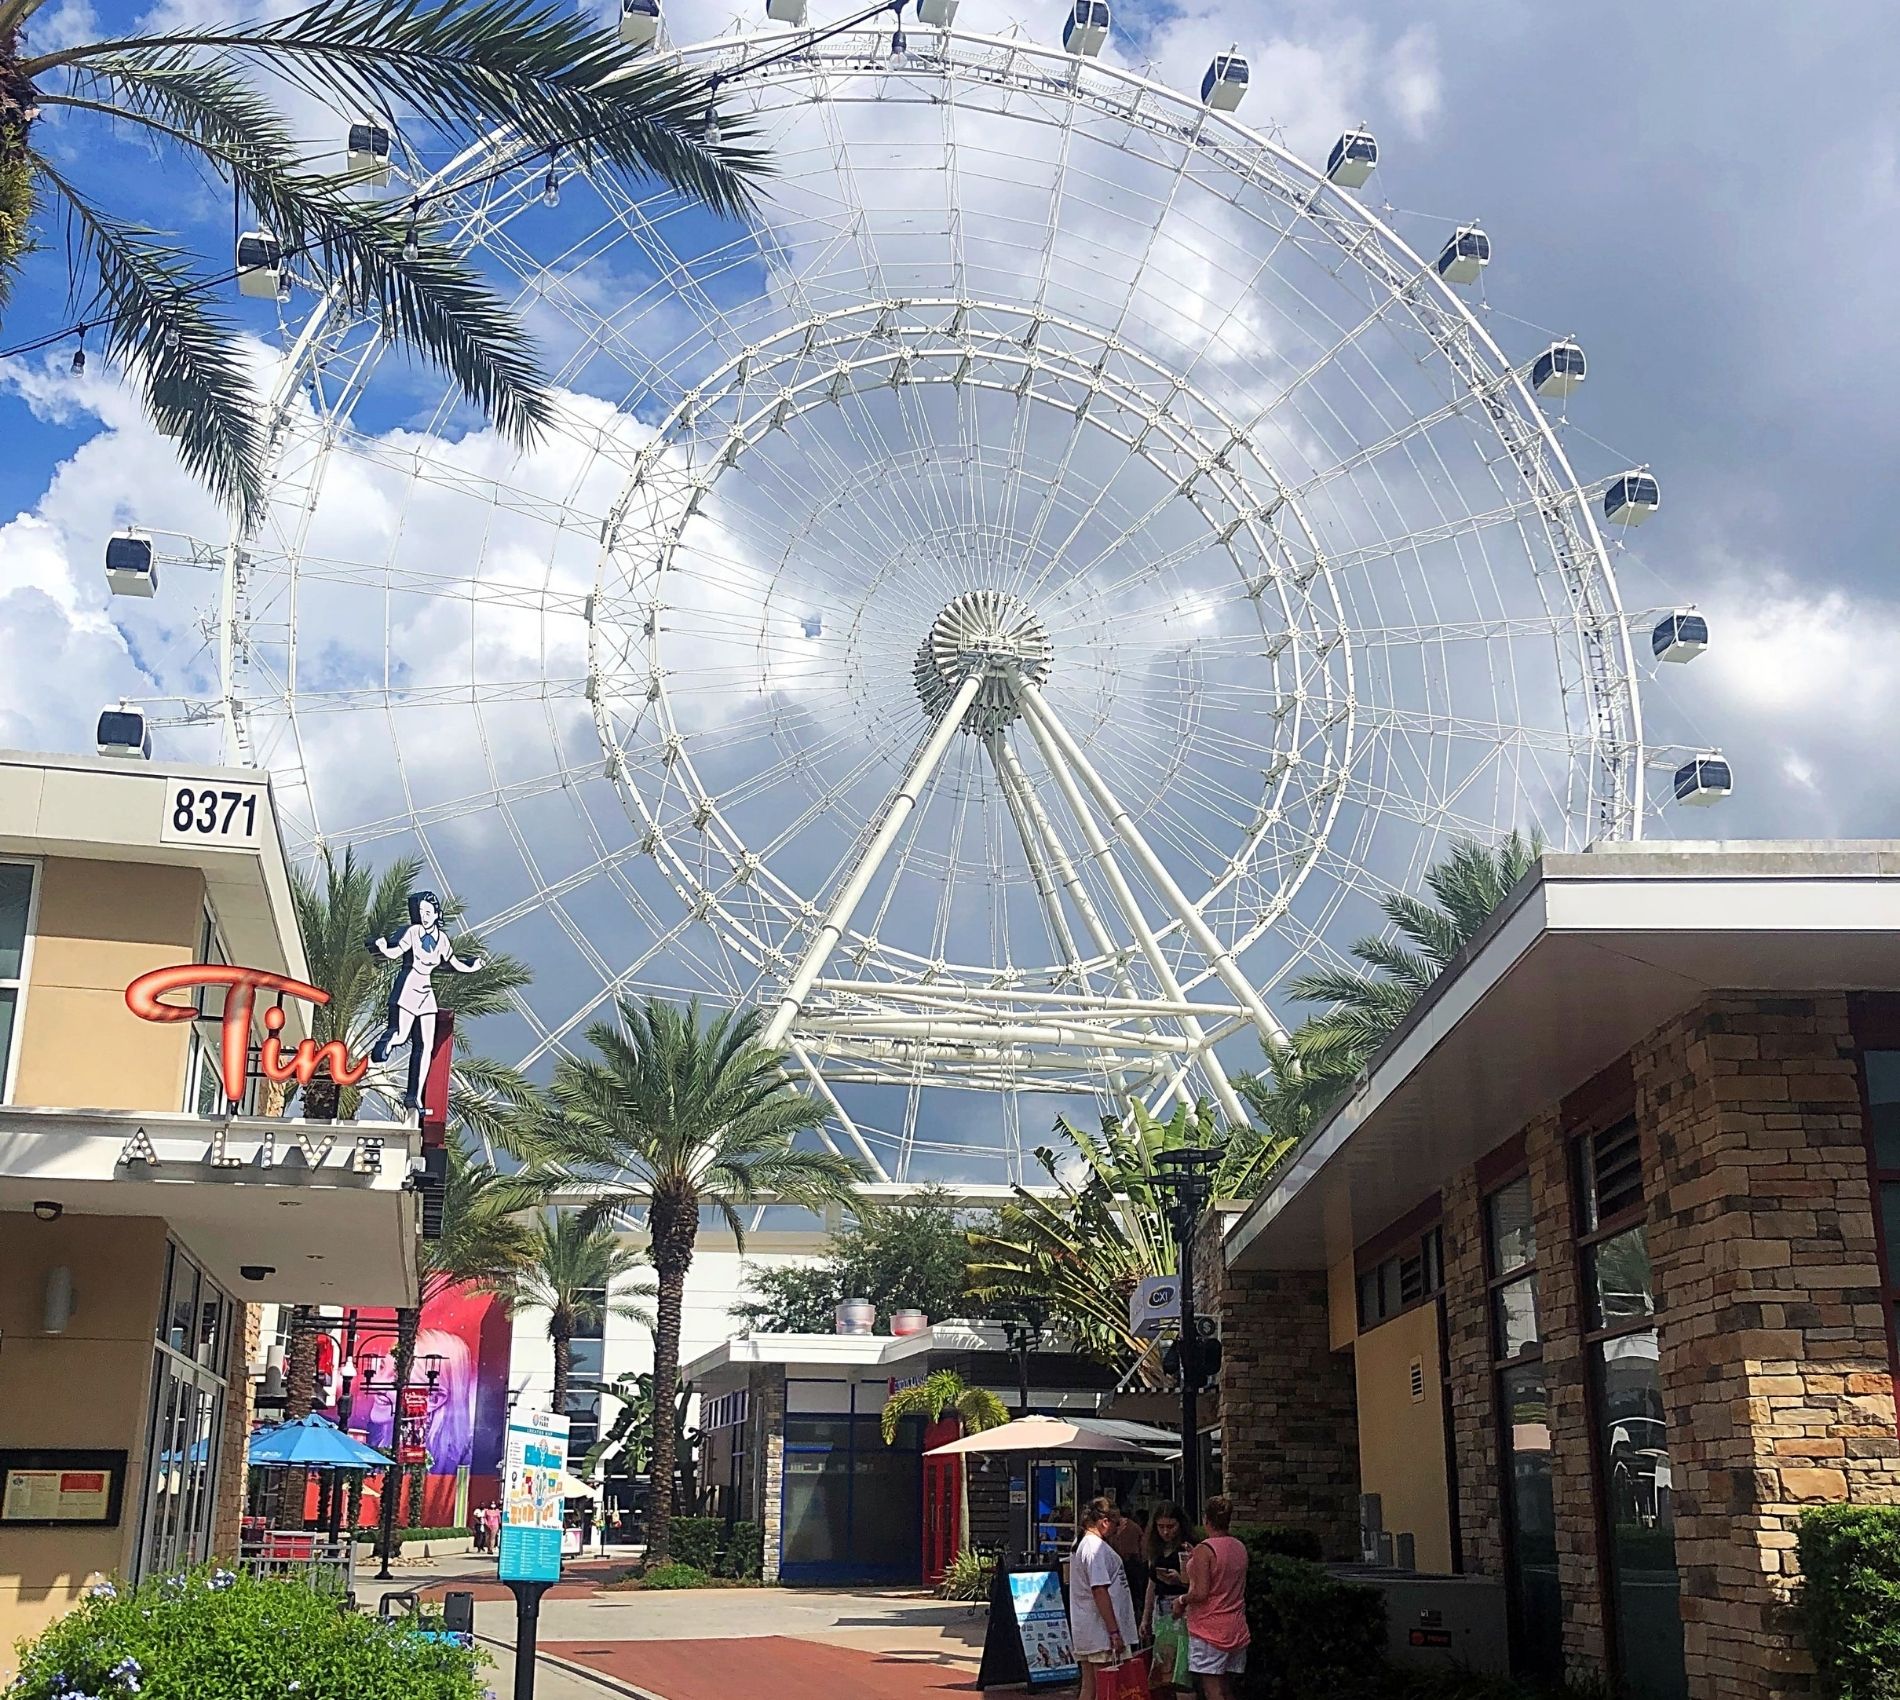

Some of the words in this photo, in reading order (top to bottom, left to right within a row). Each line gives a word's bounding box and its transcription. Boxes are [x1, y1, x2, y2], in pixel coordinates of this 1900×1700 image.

[173, 788, 257, 836] 8371
[125, 964, 369, 1102] Tin
[118, 1127, 161, 1167] A
[211, 1130, 384, 1175] LIVE
[1152, 1292, 1168, 1303] CXI
